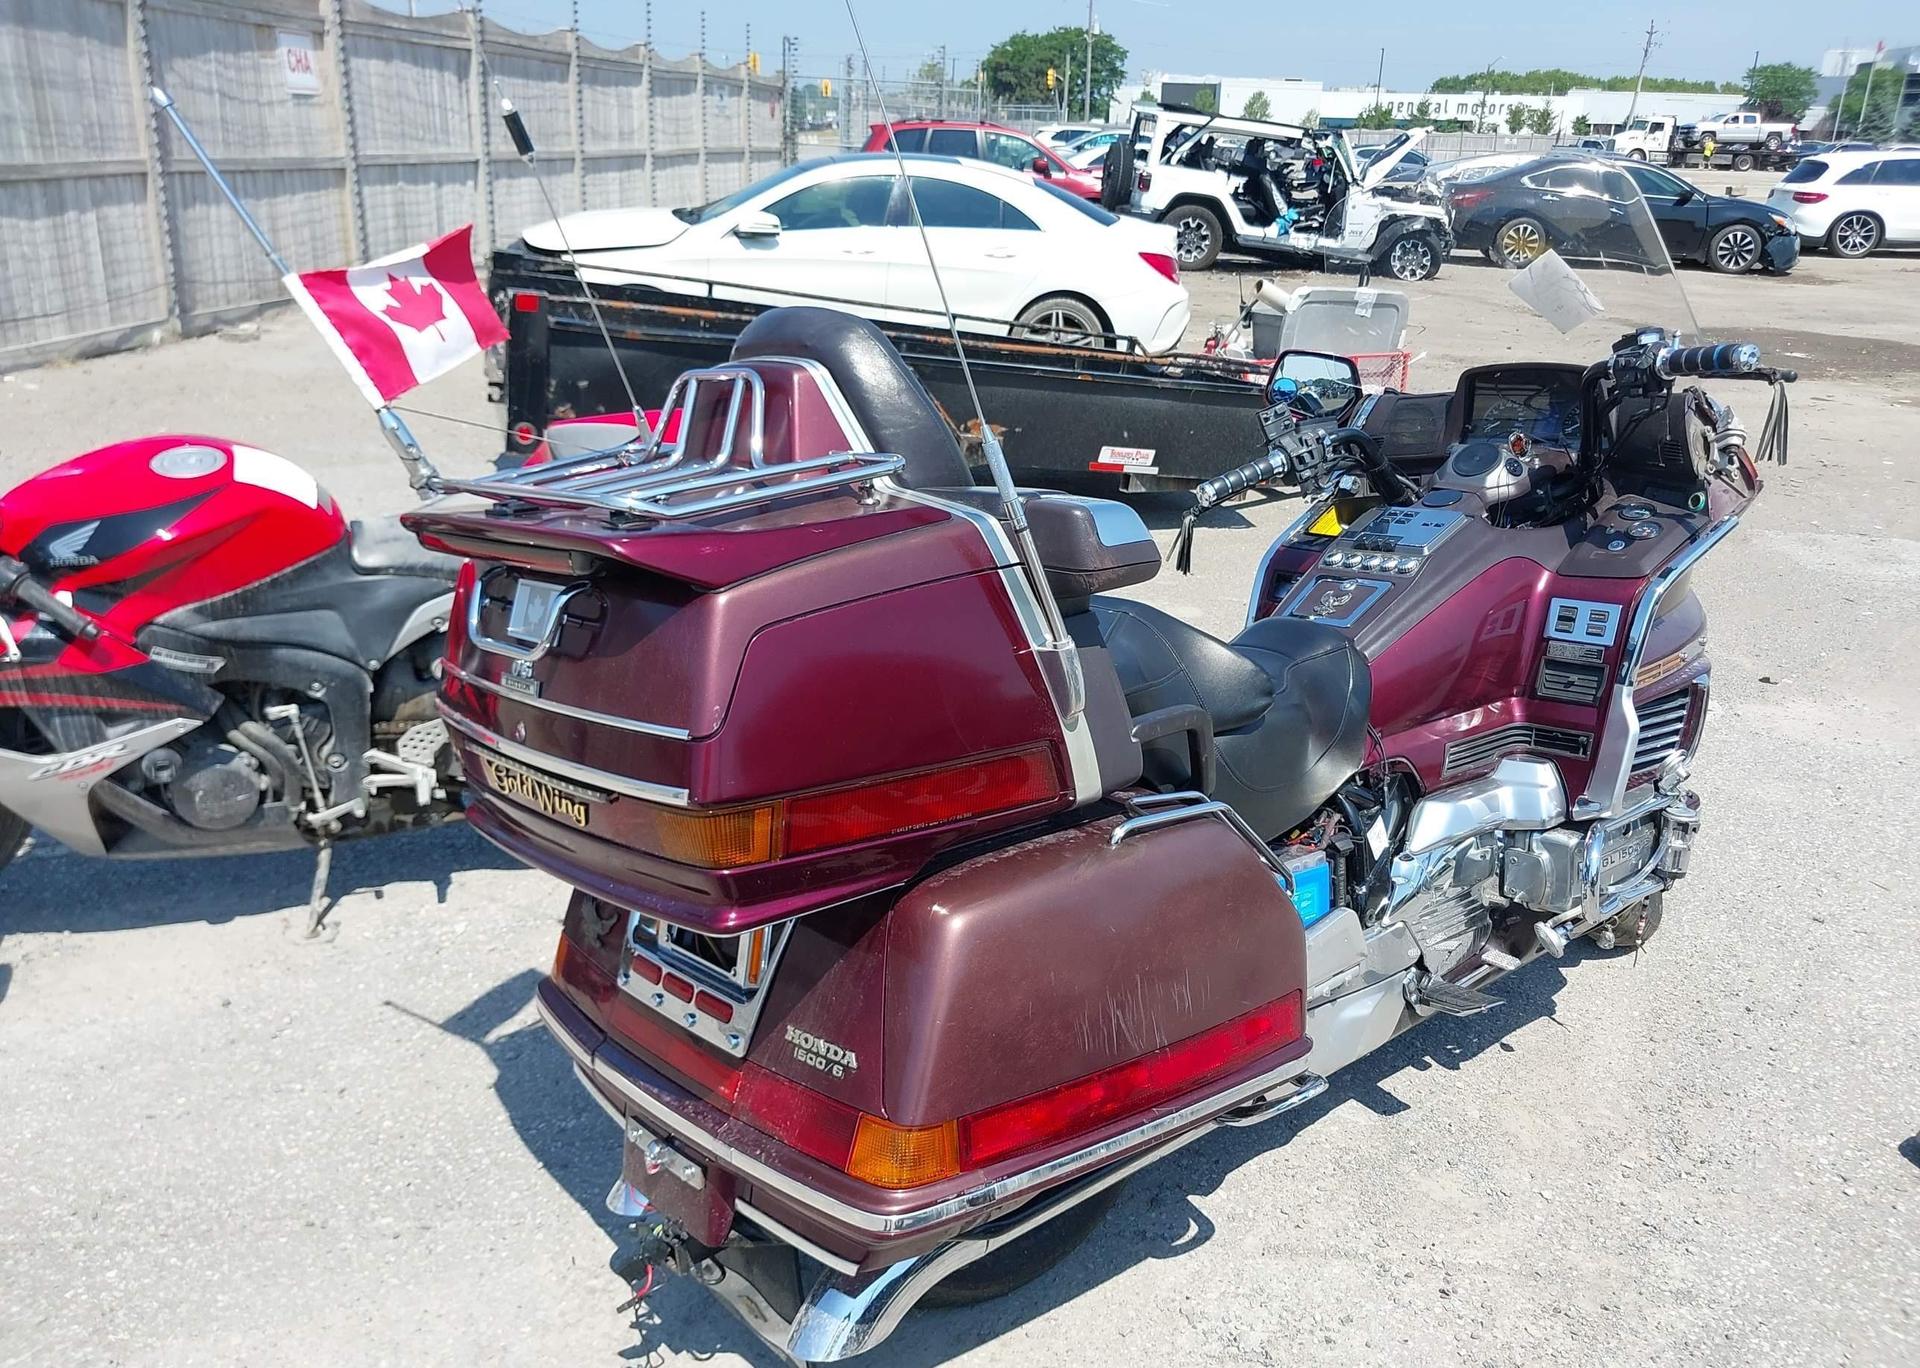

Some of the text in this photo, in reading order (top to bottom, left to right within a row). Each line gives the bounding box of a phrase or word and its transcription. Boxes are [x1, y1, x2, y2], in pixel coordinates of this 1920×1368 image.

[49, 554, 100, 568] HONDA
[1602, 855, 1616, 868] GL
[784, 1024, 858, 1070] HONDA
[793, 1046, 844, 1078] 1500/6
